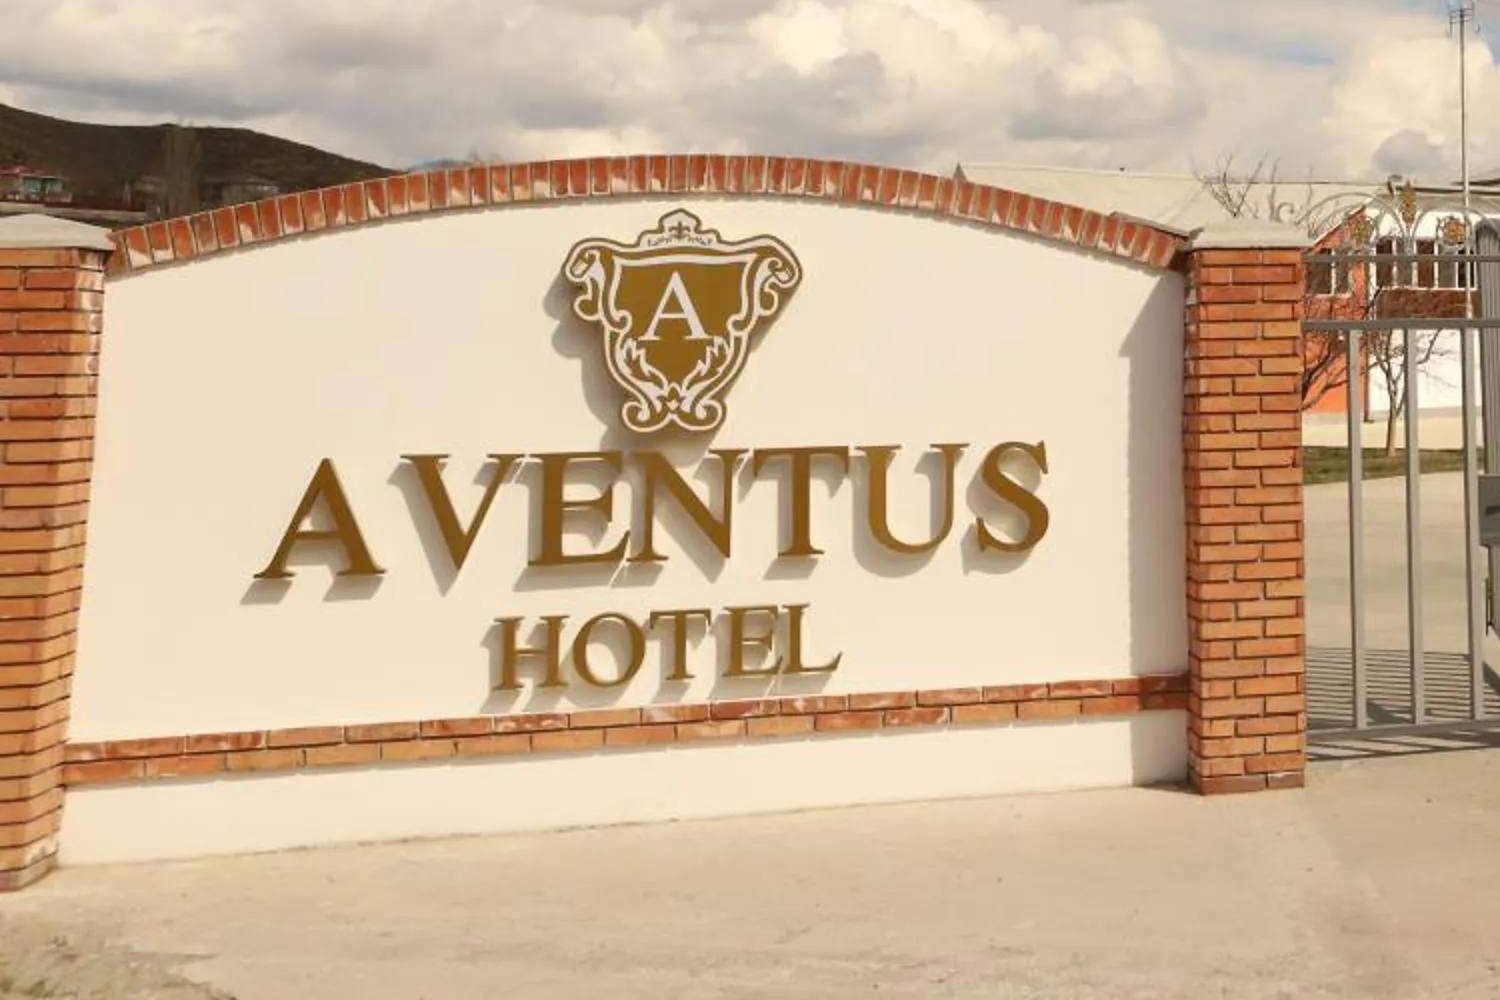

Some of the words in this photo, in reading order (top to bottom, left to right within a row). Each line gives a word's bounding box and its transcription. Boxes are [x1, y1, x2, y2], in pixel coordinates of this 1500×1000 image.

[638, 270, 712, 341] A
[252, 440, 1050, 579] AVENTUS
[493, 602, 843, 692] HOTEL
